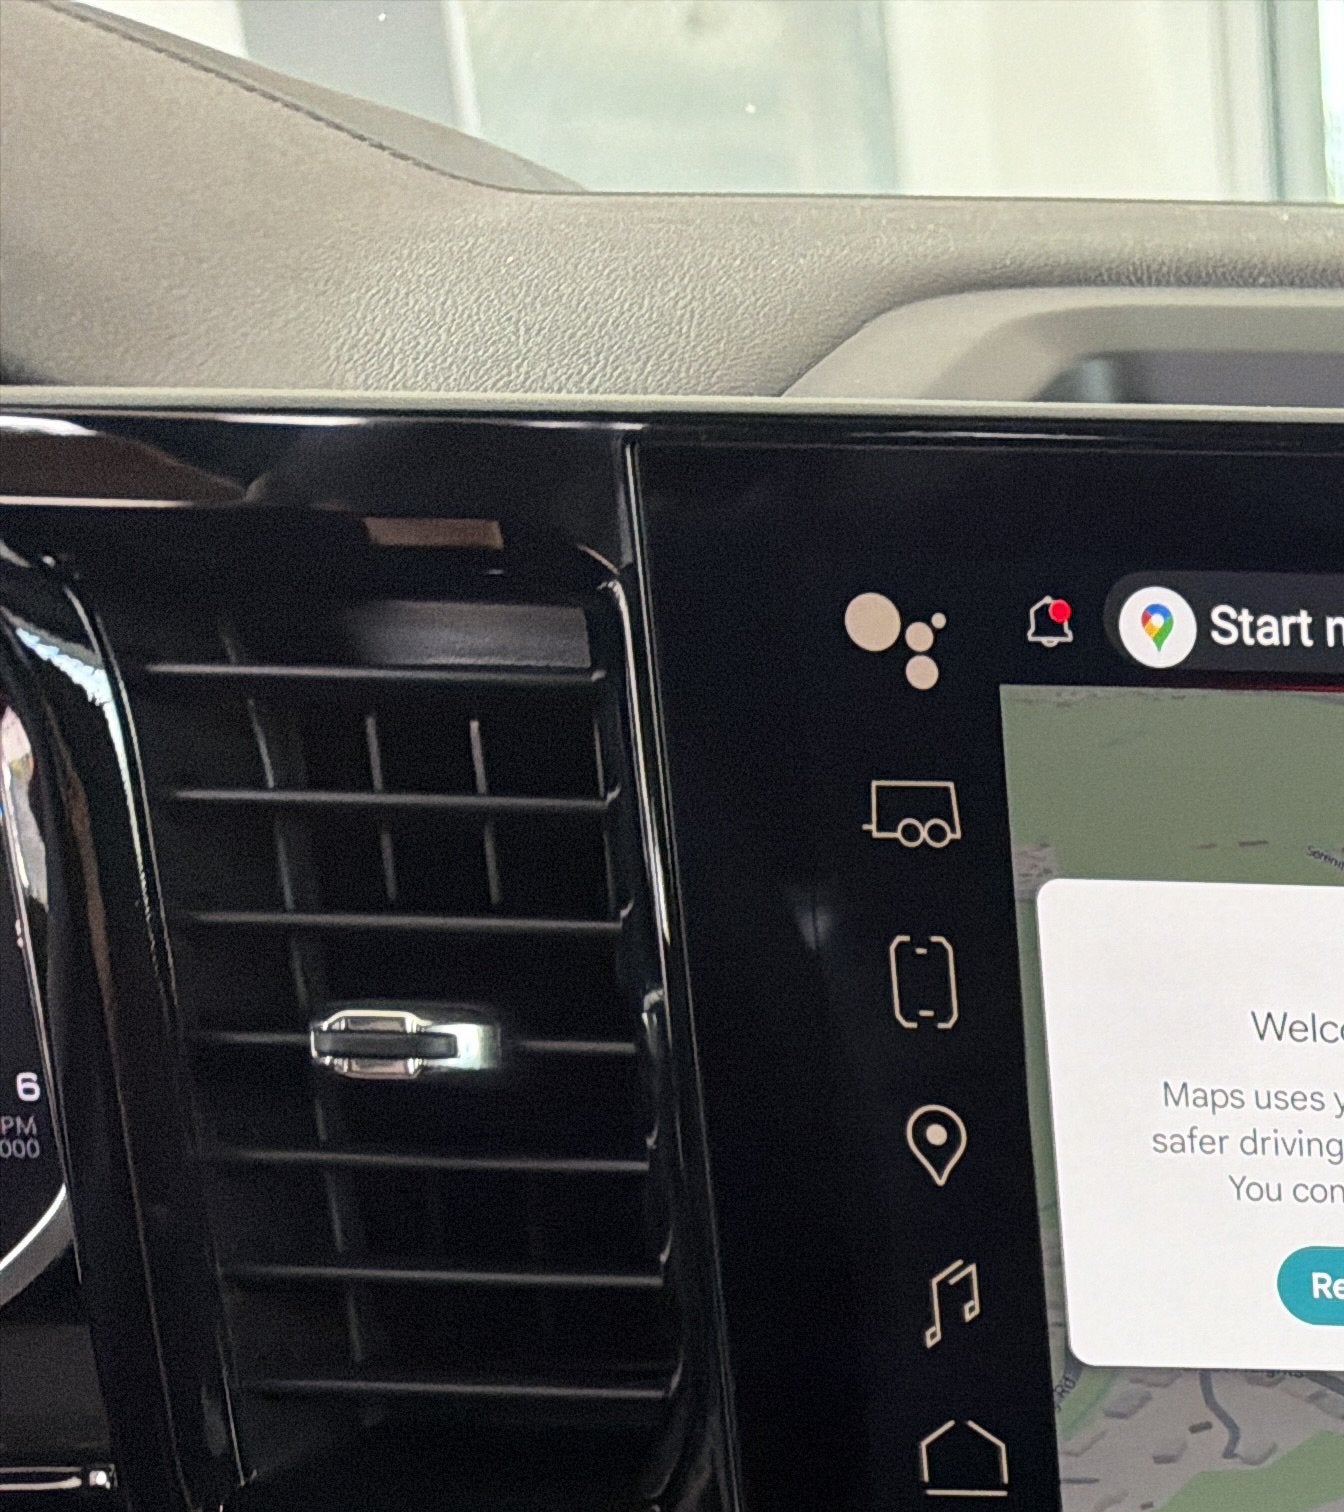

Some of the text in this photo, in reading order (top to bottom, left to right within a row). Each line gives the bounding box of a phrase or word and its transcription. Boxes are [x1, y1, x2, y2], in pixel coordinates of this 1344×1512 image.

[1210, 604, 1314, 647] Start
[16, 1071, 41, 1102] 6
[1163, 1080, 1246, 1115] Maps
[1254, 1089, 1326, 1112] uses
[0, 1115, 38, 1136] PM
[1152, 1125, 1230, 1155] safer
[1239, 1127, 1344, 1166] driving
[1228, 1174, 1283, 1202] You
